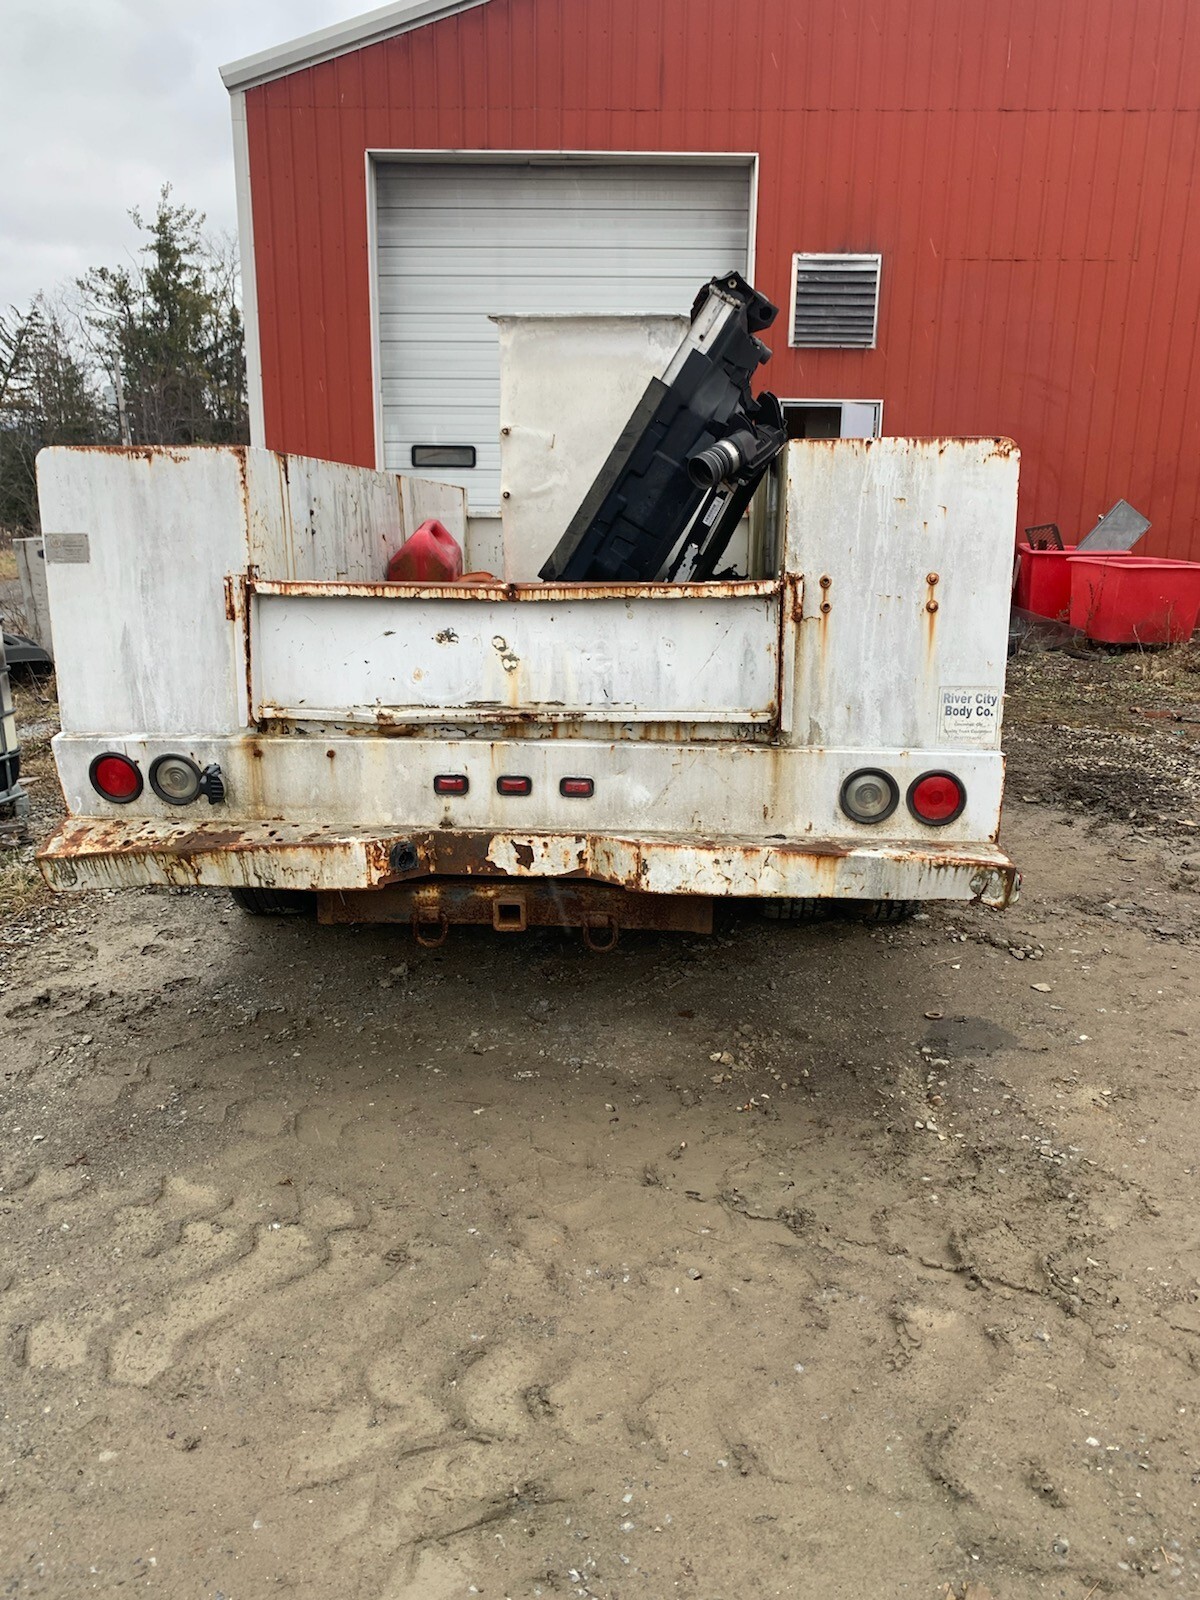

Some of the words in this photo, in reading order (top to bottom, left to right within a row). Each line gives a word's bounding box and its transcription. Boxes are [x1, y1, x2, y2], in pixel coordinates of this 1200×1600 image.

[943, 693, 972, 704] River
[975, 693, 998, 707] City
[945, 705, 973, 719] Body
[976, 705, 993, 717] Co.
